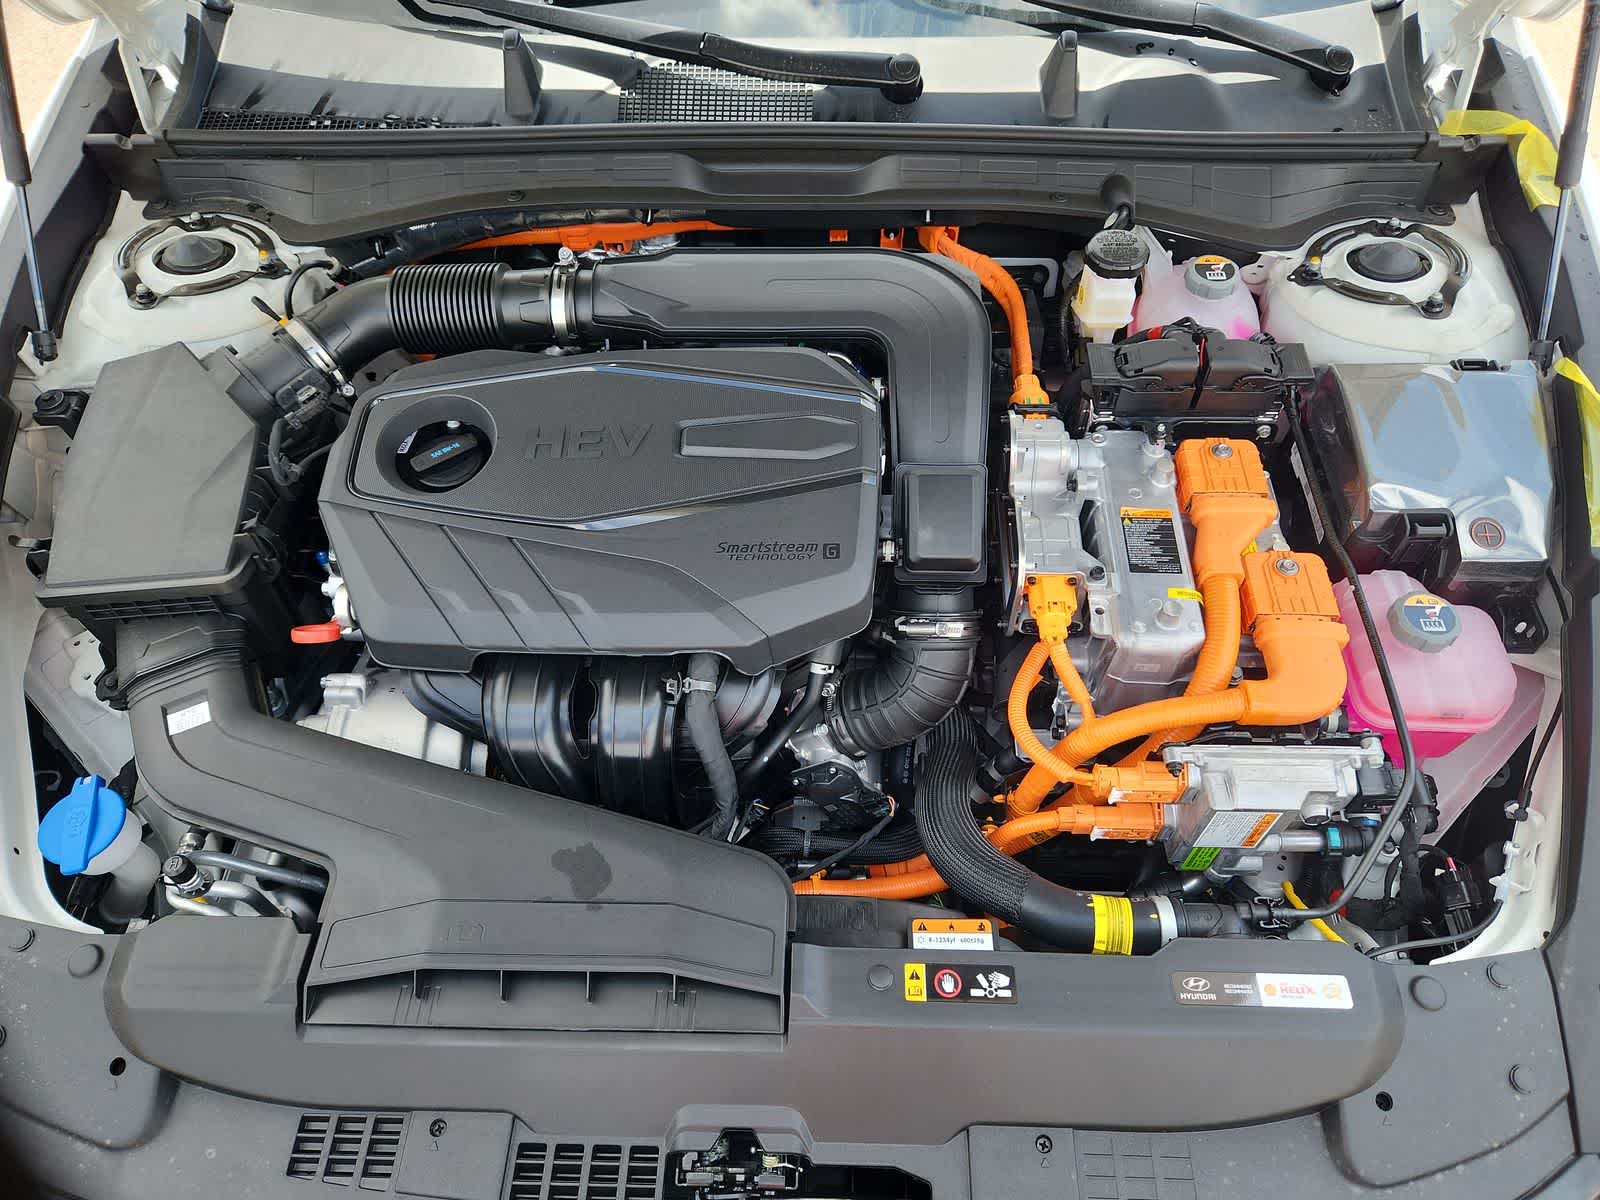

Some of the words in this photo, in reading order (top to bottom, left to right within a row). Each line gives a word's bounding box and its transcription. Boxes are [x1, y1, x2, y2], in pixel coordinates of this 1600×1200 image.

[525, 423, 653, 459] HEV
[715, 541, 819, 553] Smartstream
[825, 543, 839, 558] G
[729, 553, 816, 561] TECHNOLOGY
[1180, 993, 1217, 1001] HYUNDAI
